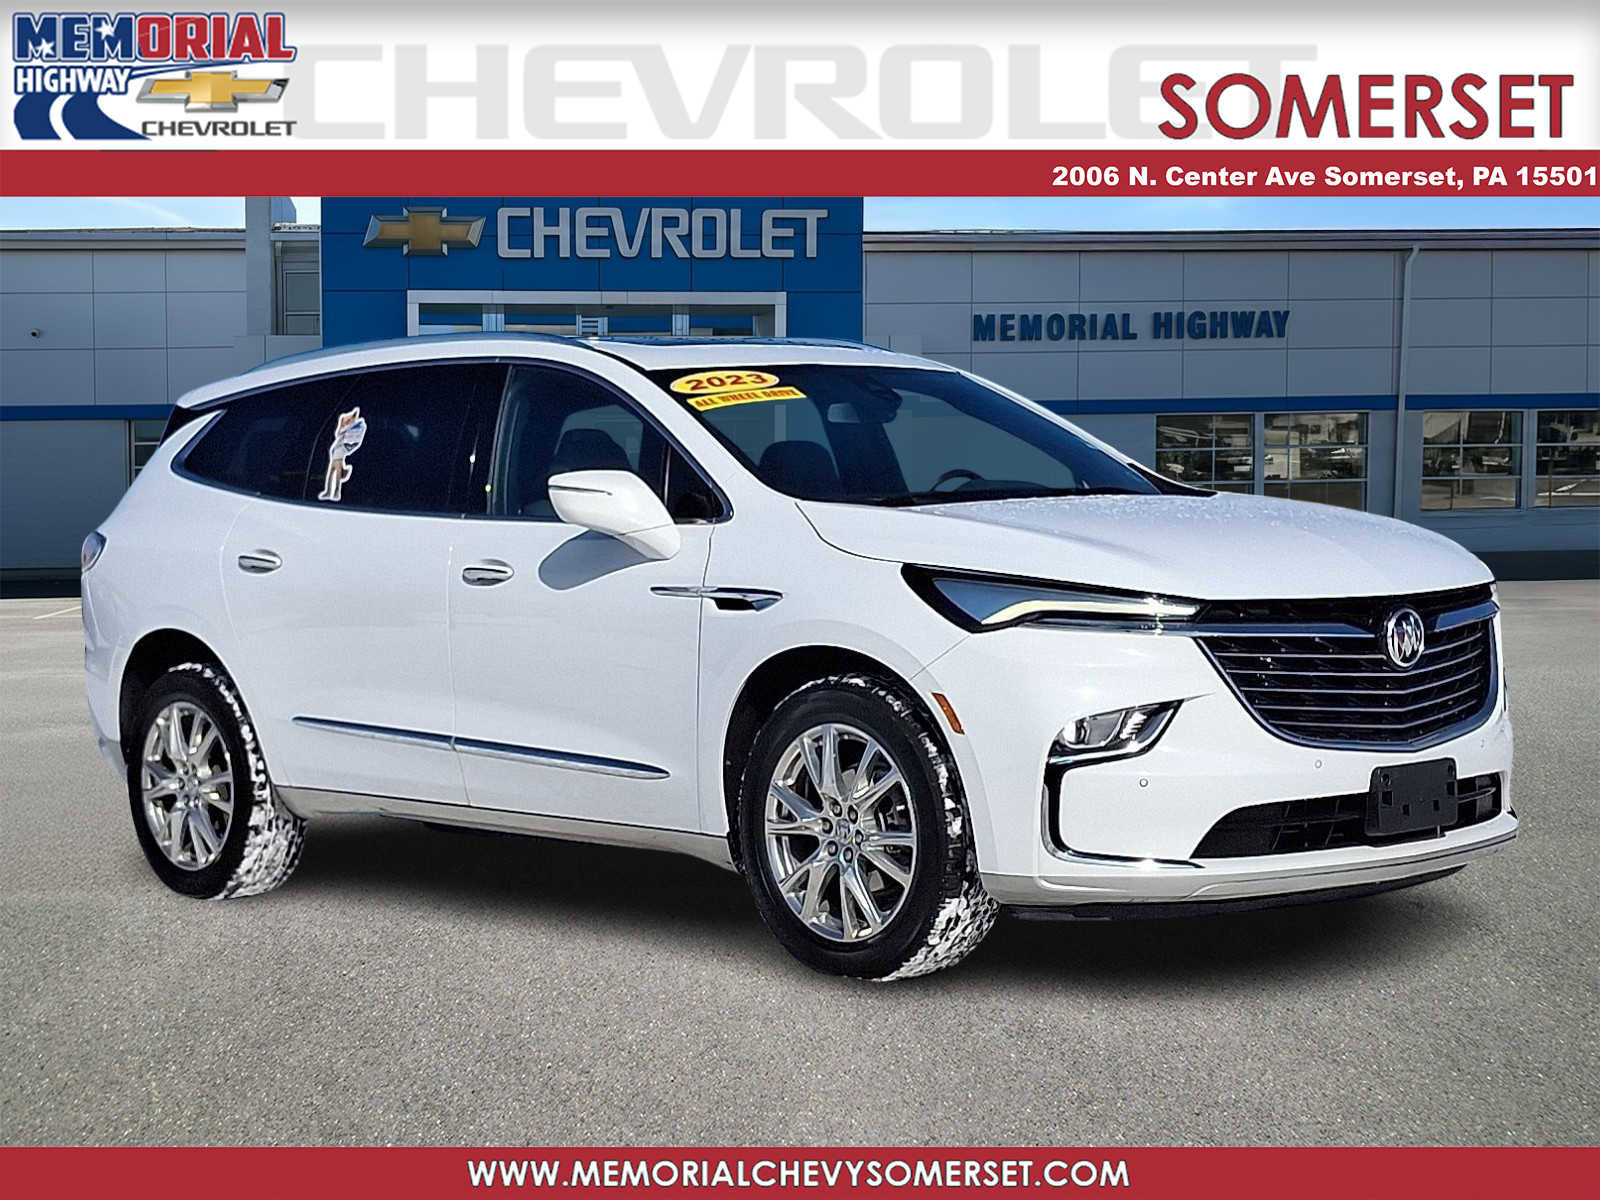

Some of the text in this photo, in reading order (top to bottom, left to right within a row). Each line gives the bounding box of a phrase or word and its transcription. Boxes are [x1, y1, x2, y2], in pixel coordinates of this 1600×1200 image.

[497, 207, 829, 259] CHEVROLET
[973, 310, 1291, 342] MEMORIAL HIGHWAY
[686, 373, 769, 391] 2023
[694, 388, 799, 408] ALL WHEEL DRIVE
